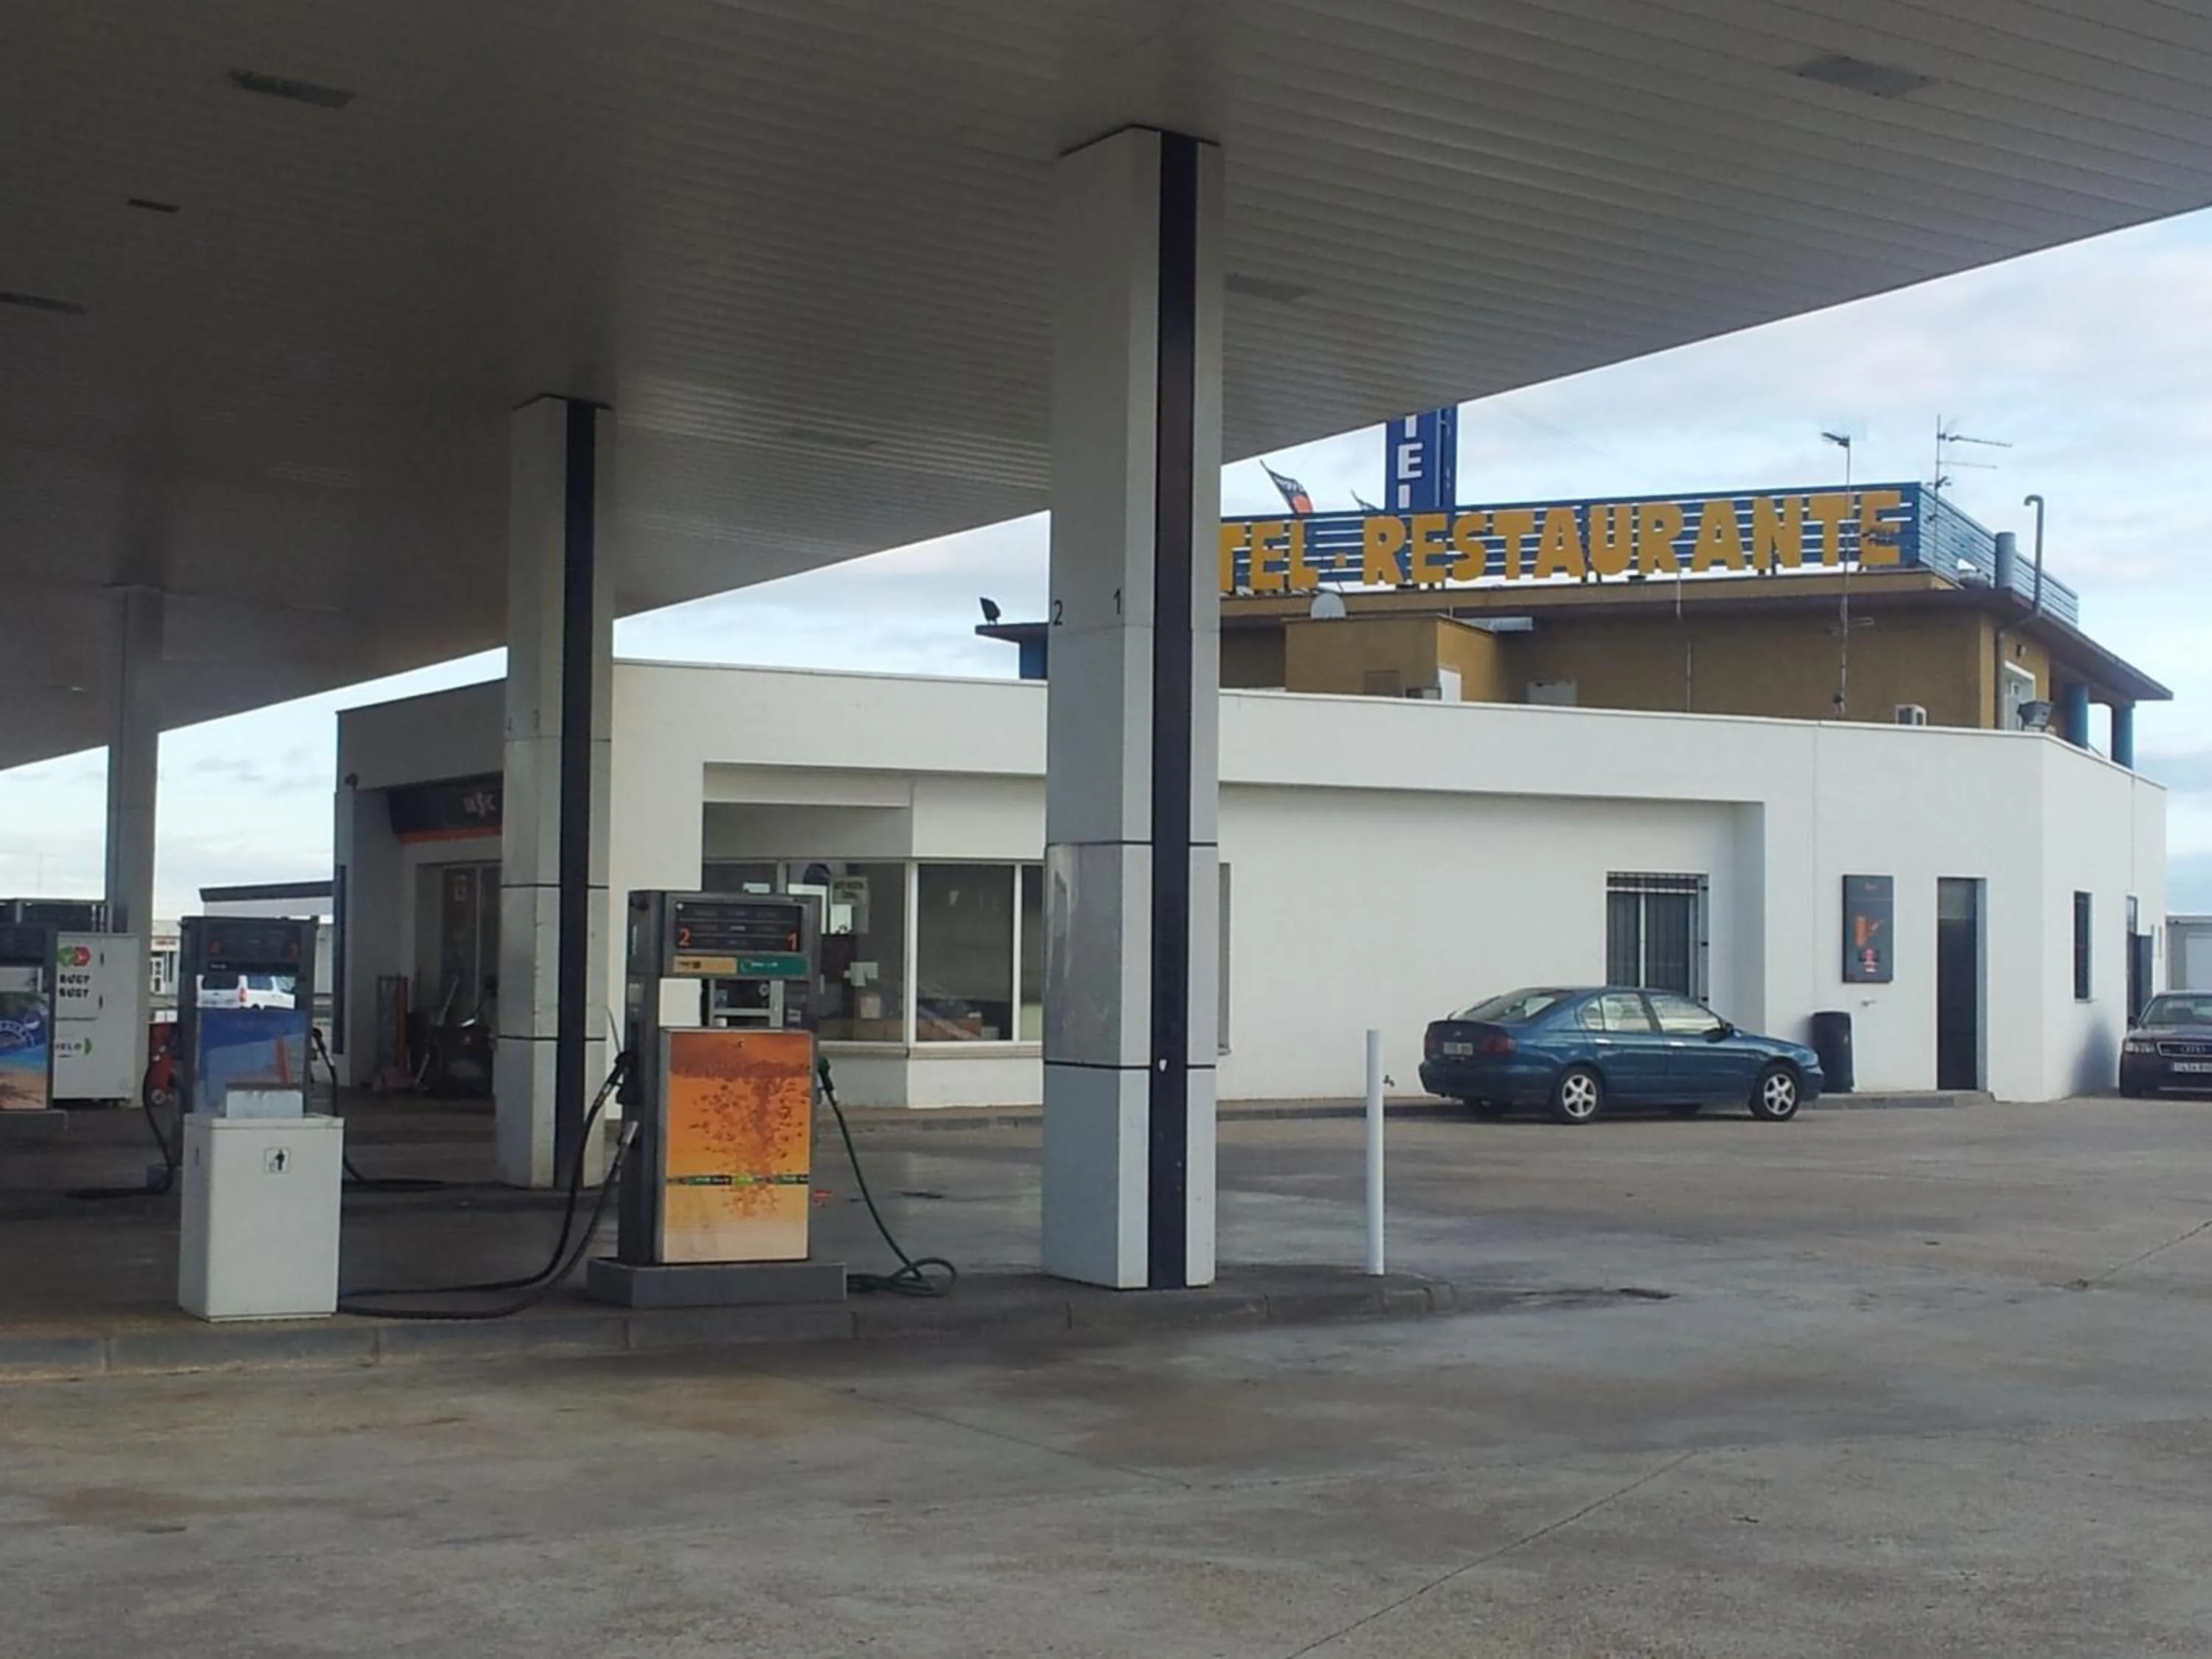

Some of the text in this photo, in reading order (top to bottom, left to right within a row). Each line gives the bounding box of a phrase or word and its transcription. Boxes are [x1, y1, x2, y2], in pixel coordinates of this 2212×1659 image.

[1363, 490, 1901, 585] RESTAURANTE
[1053, 599, 1063, 625] 2
[1113, 588, 1121, 615] 1
[678, 927, 692, 947] 2
[787, 931, 798, 951] 1
